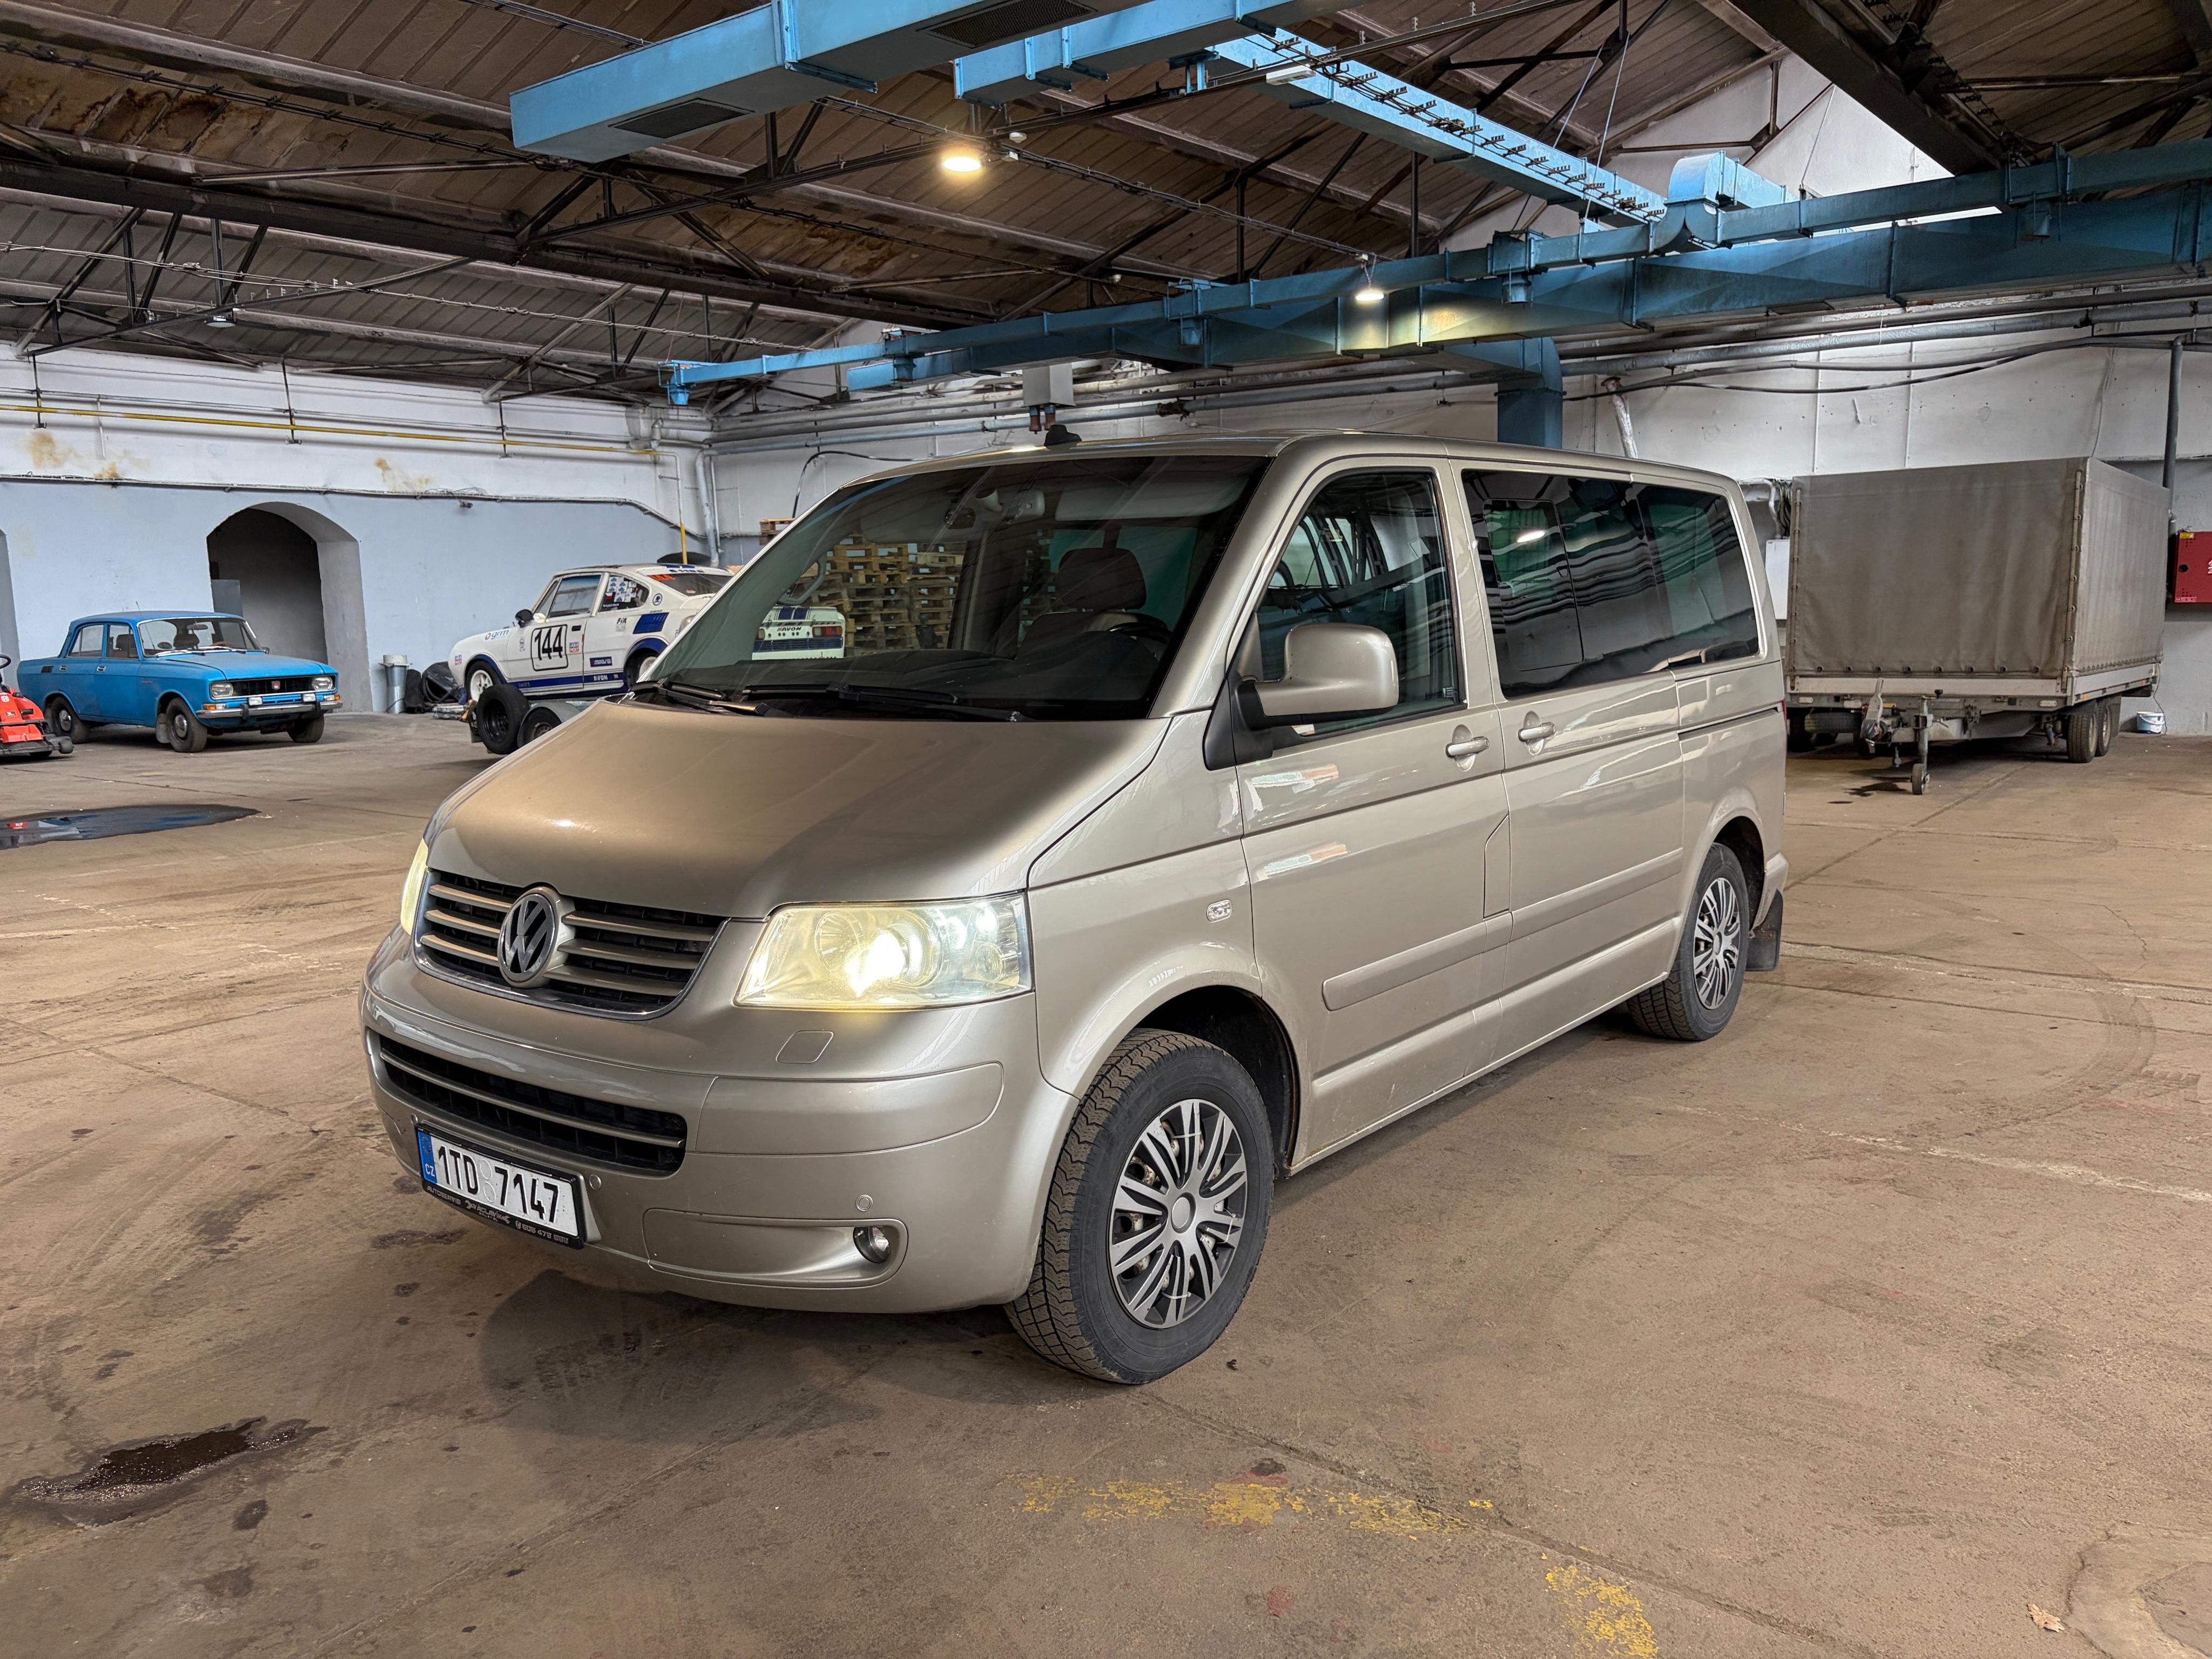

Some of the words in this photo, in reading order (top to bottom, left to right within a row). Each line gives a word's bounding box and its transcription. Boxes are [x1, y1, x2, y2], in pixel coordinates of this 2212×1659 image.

[534, 626, 563, 661] 144
[425, 1163, 435, 1177] CZ
[427, 1185, 462, 1205] AUTOSERVIS
[494, 1164, 559, 1224] 7147
